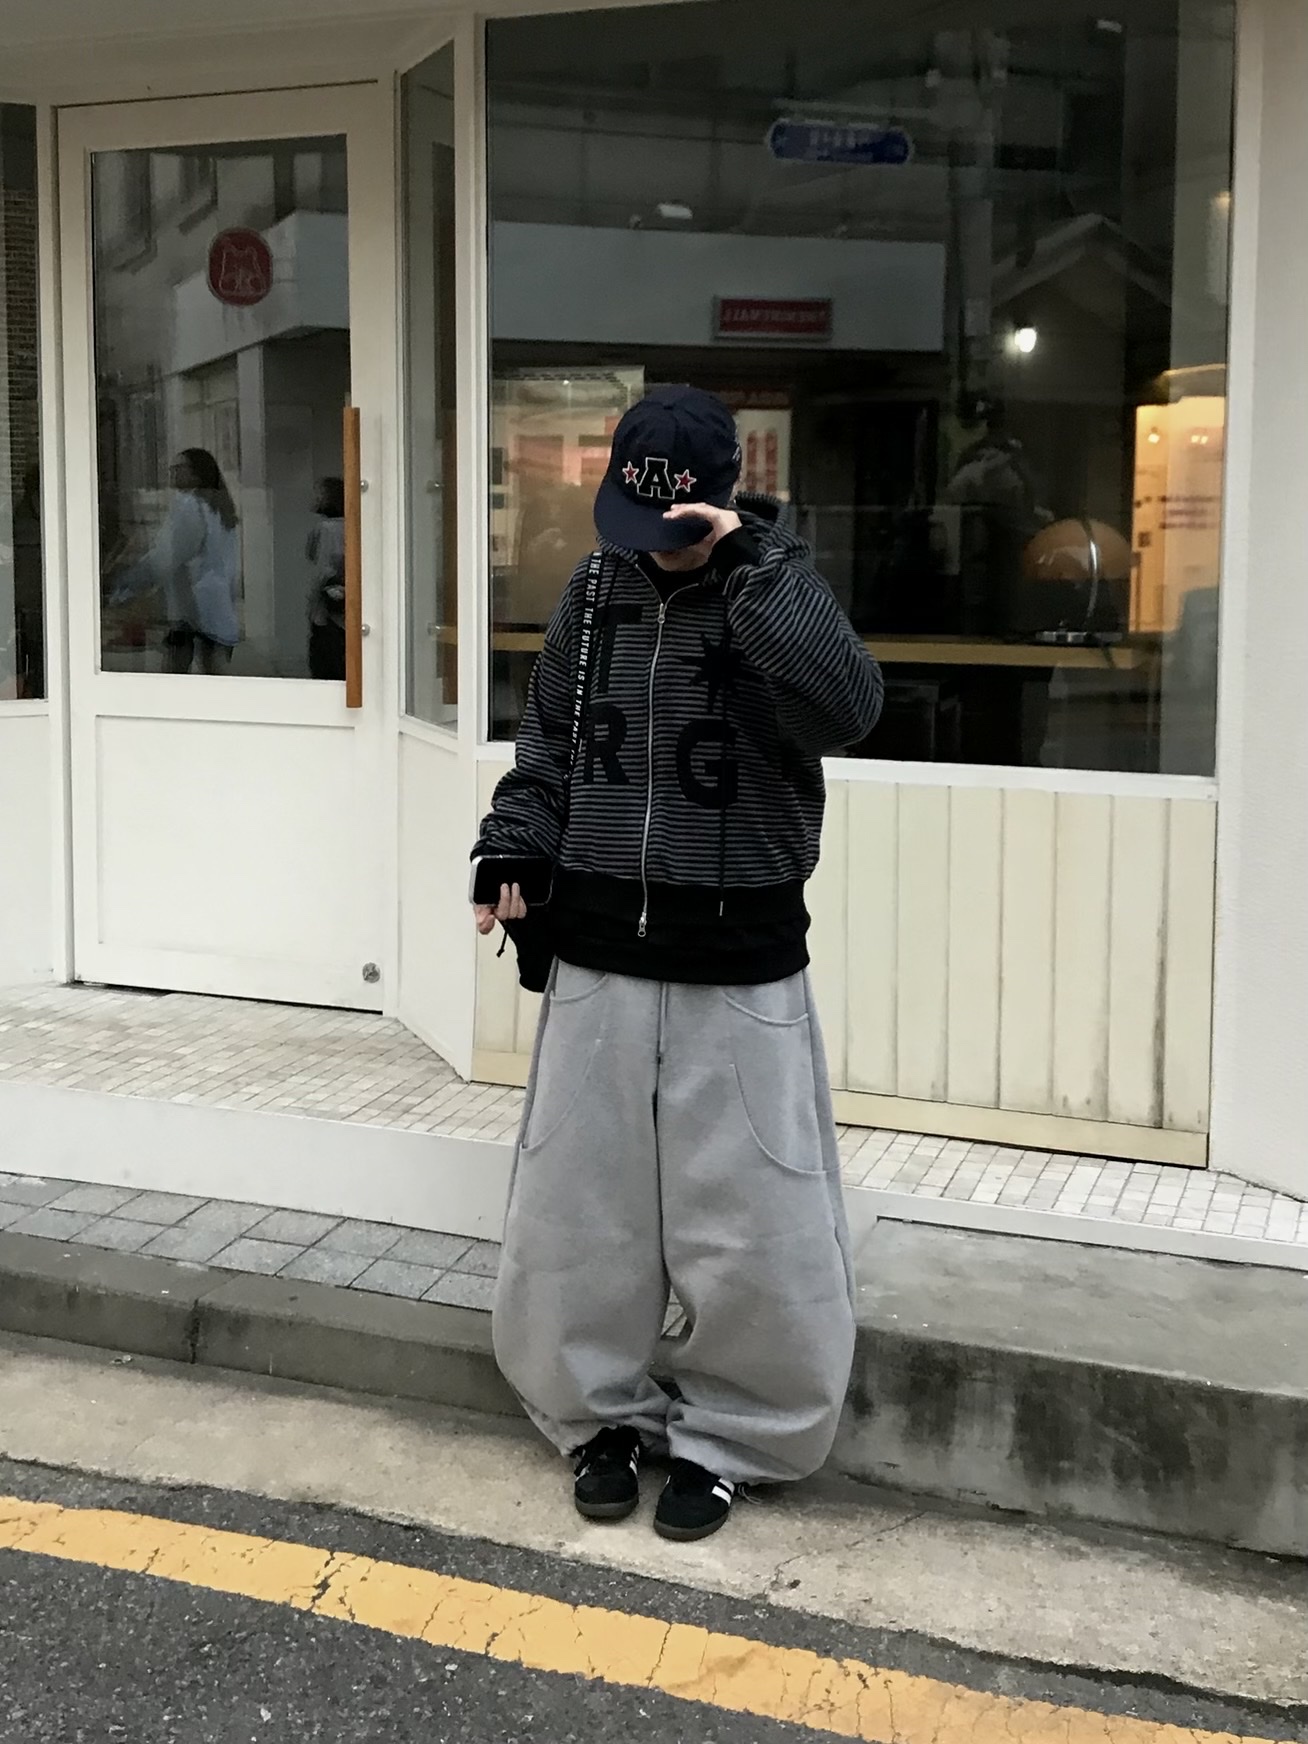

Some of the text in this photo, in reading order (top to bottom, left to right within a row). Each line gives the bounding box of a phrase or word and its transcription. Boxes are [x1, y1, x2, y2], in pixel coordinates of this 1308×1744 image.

[637, 457, 675, 500] A
[588, 559, 602, 575] THE
[585, 578, 598, 602] PAST
[583, 608, 594, 625] THE
[579, 629, 591, 667] FUTURE
[577, 670, 586, 681] IS
[576, 684, 584, 696] IN
[574, 699, 582, 717] THE
[583, 704, 738, 810] R G
